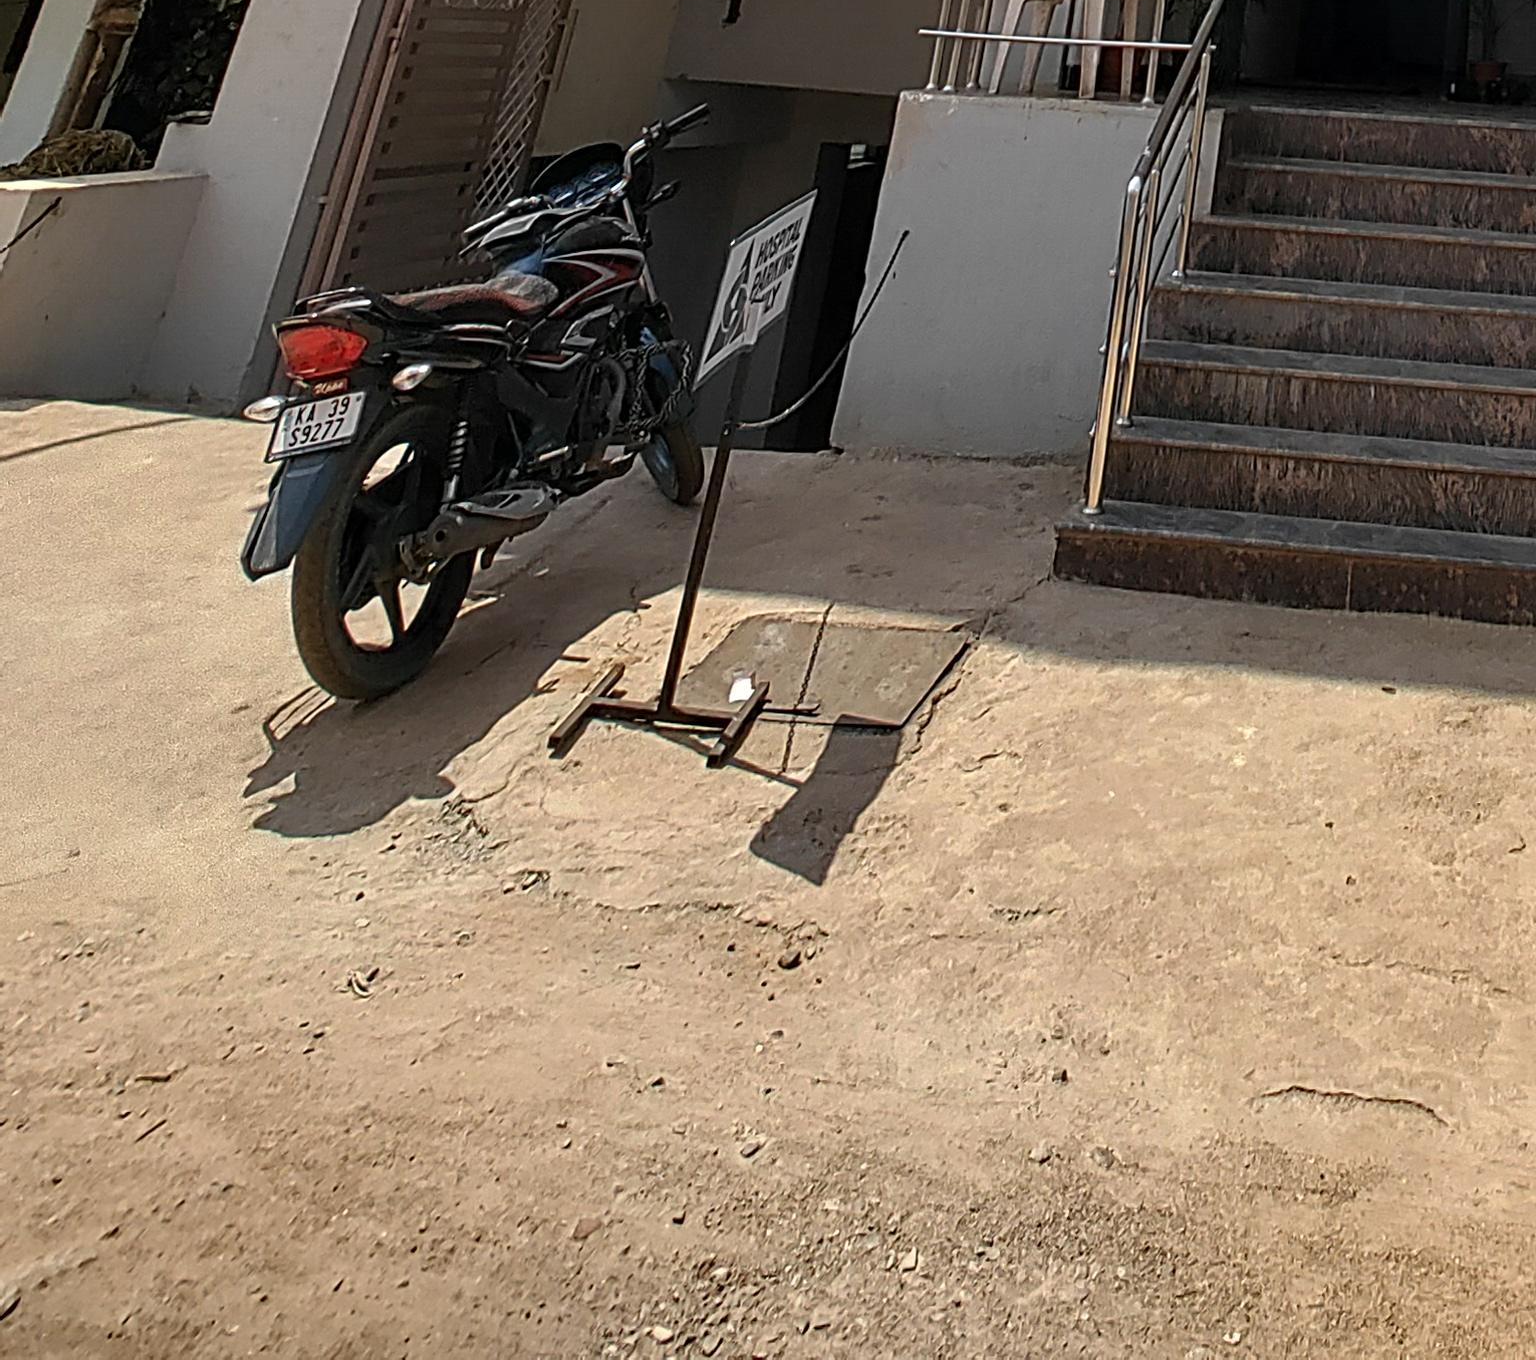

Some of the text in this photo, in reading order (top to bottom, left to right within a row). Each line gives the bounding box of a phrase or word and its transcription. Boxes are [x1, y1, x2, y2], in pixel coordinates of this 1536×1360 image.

[754, 217, 803, 269] HOSPITAL
[294, 395, 350, 426] KA 39
[288, 418, 345, 447] S9277
